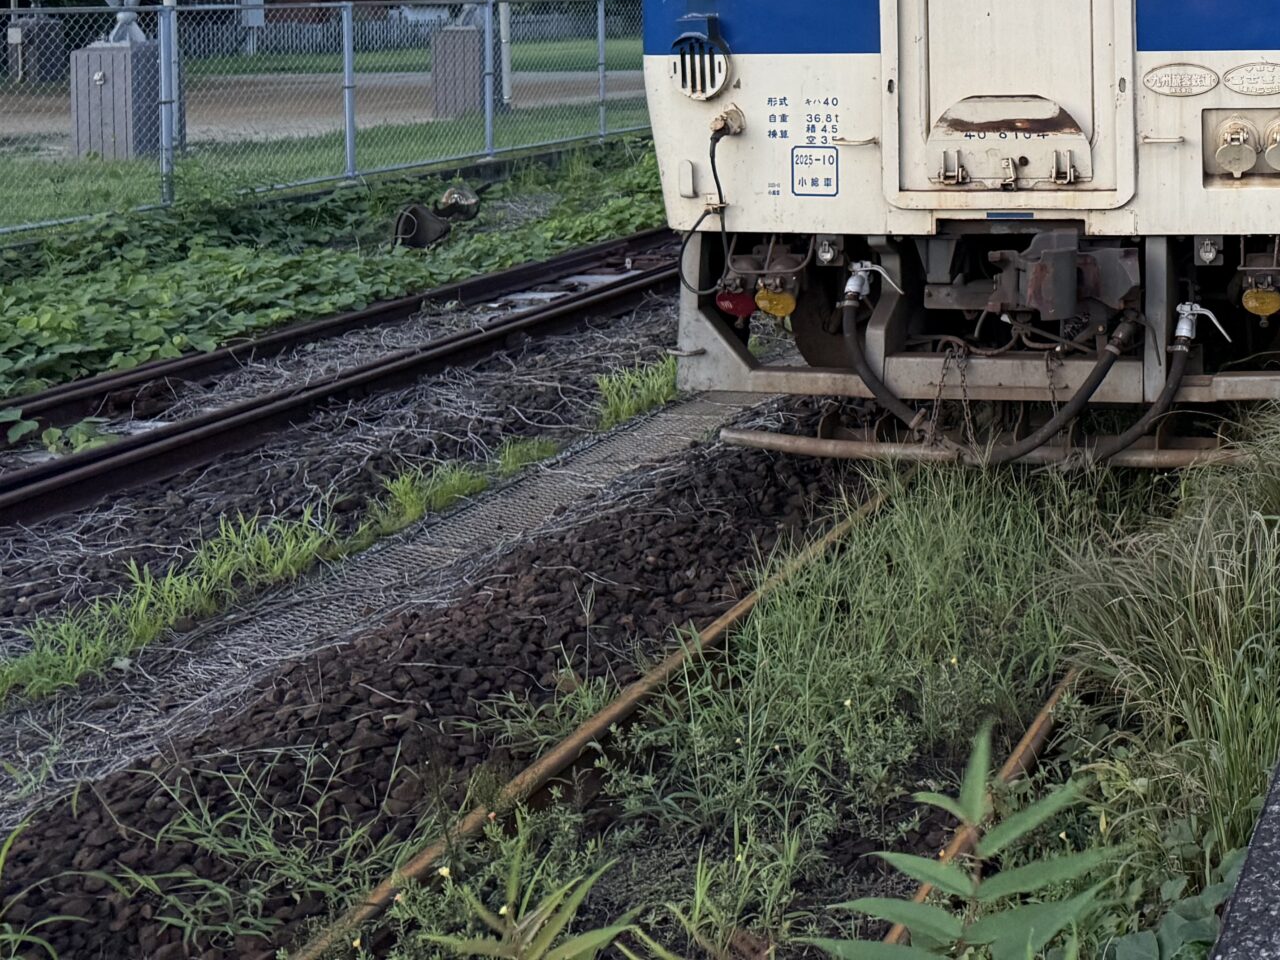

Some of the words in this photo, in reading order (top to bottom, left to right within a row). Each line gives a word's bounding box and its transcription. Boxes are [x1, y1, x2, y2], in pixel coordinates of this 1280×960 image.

[767, 97, 788, 107] 形式
[805, 97, 839, 107] キハ40
[769, 113, 790, 123] 自重
[821, 124, 838, 134] 4.5
[795, 154, 835, 166] 2025-10
